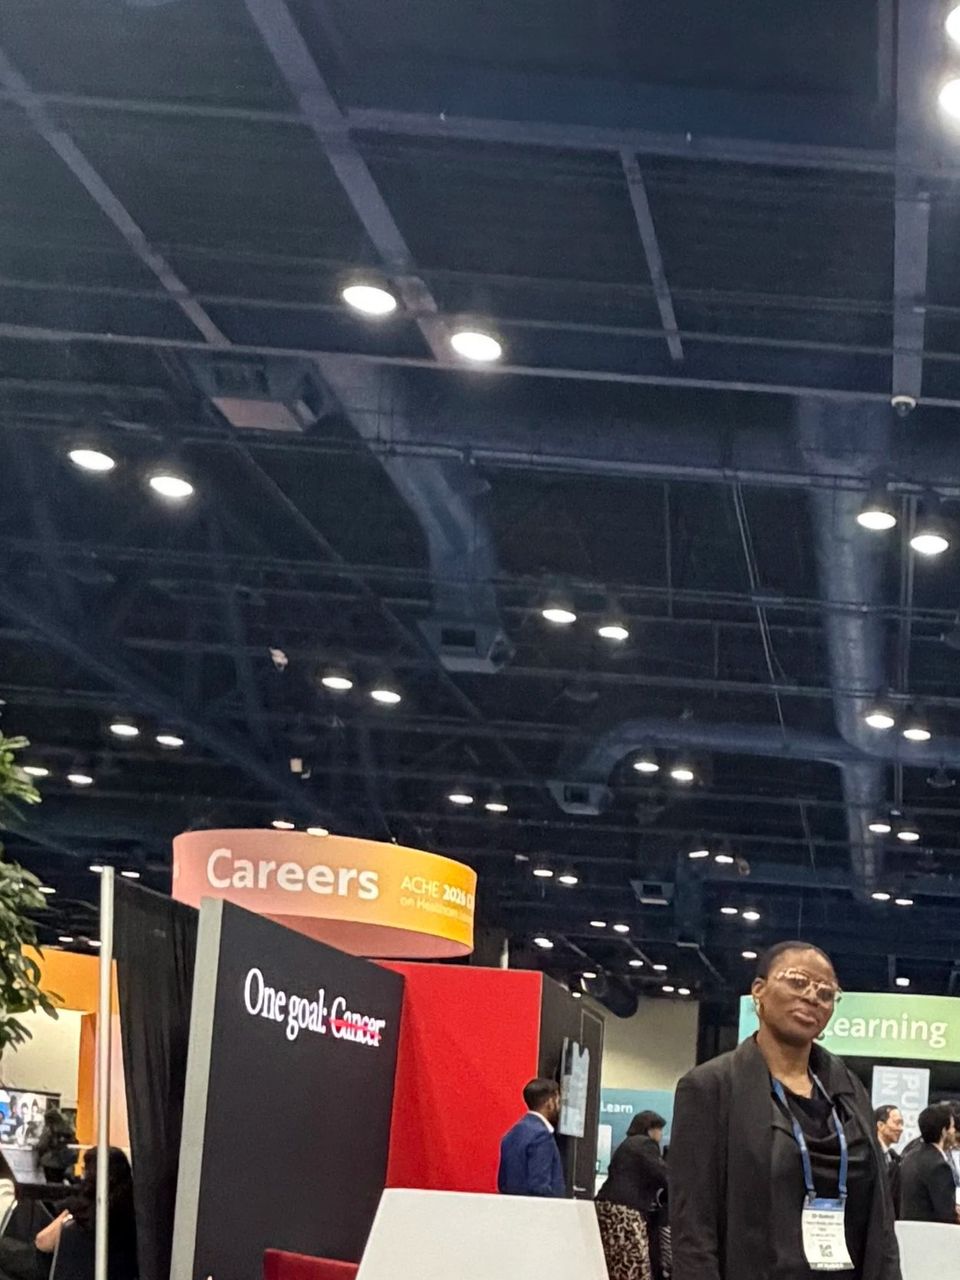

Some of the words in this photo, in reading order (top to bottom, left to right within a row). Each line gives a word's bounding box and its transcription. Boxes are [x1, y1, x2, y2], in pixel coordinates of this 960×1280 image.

[206, 847, 380, 900] Careers
[400, 875, 439, 898] ACHE
[442, 883, 467, 906] 2026
[244, 967, 286, 1022] One
[286, 987, 326, 1041] goal:
[329, 996, 386, 1047] Cancer
[601, 1101, 633, 1114] Learn
